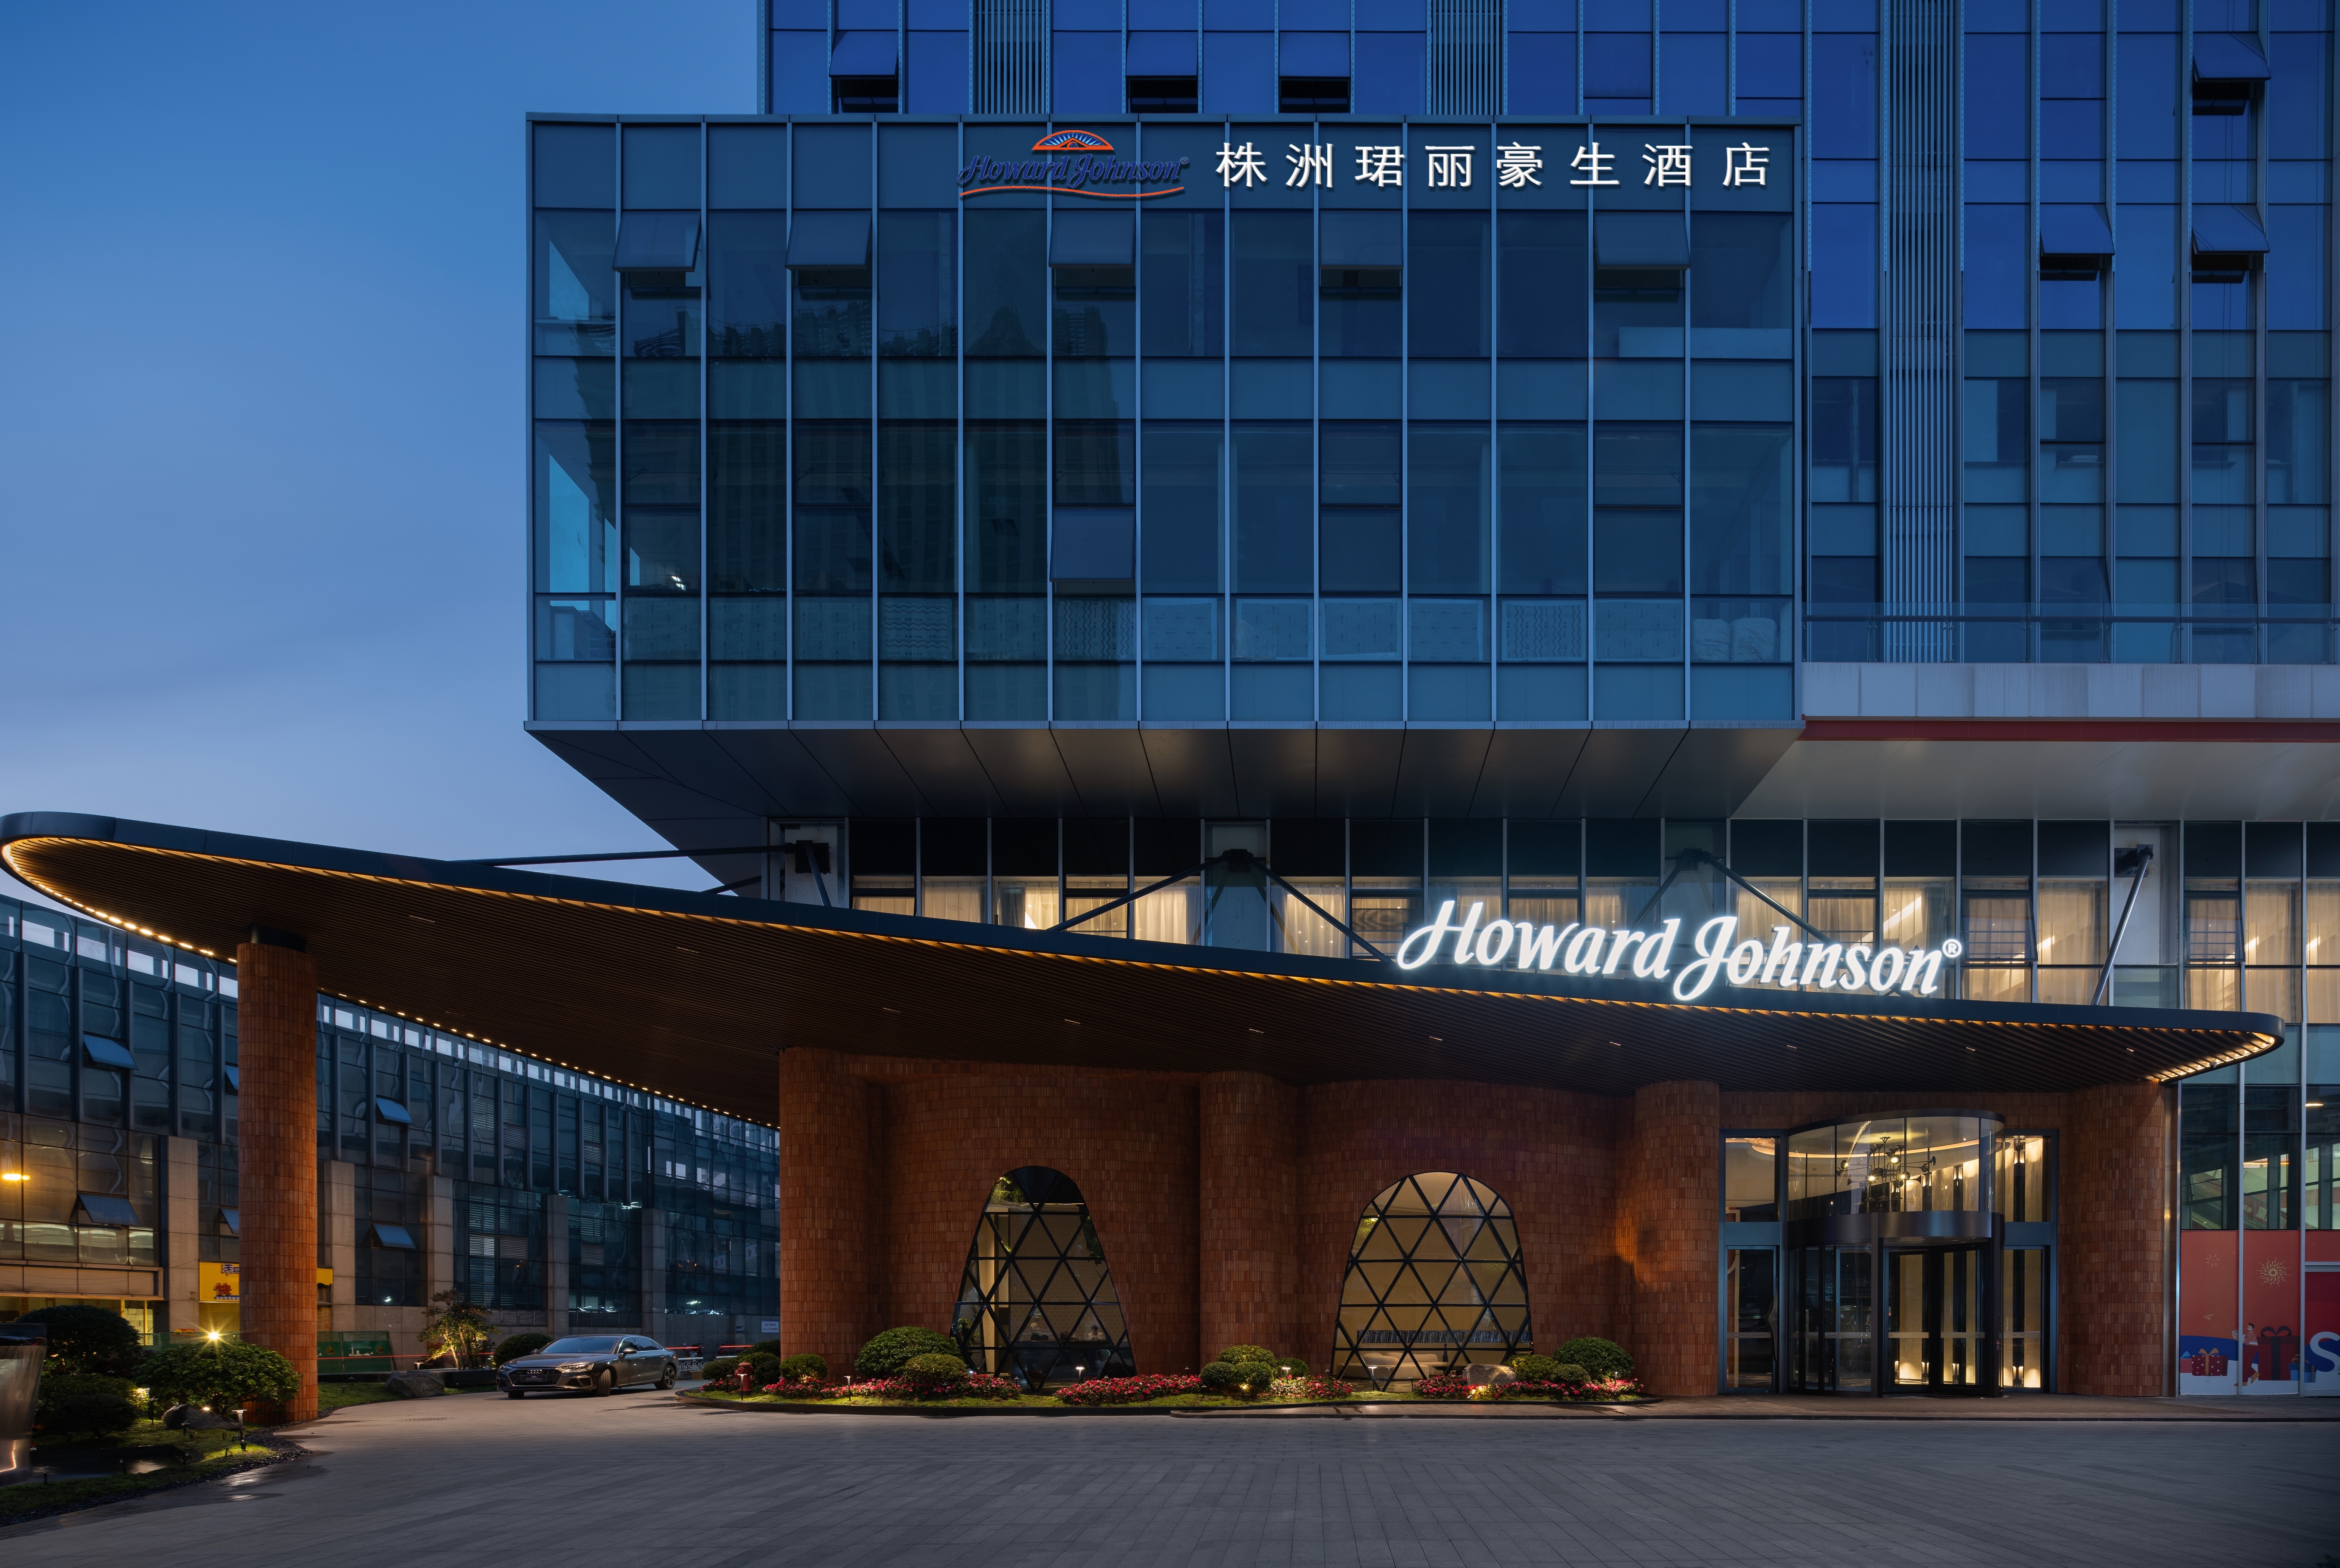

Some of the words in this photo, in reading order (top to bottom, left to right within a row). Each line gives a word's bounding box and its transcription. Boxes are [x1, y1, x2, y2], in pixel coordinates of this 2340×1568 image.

[957, 155, 1069, 184] Howard
[1215, 142, 1770, 188] 株洲珺丽豪生酒店
[1397, 900, 1681, 979] Howard
[214, 1283, 232, 1295] 快
